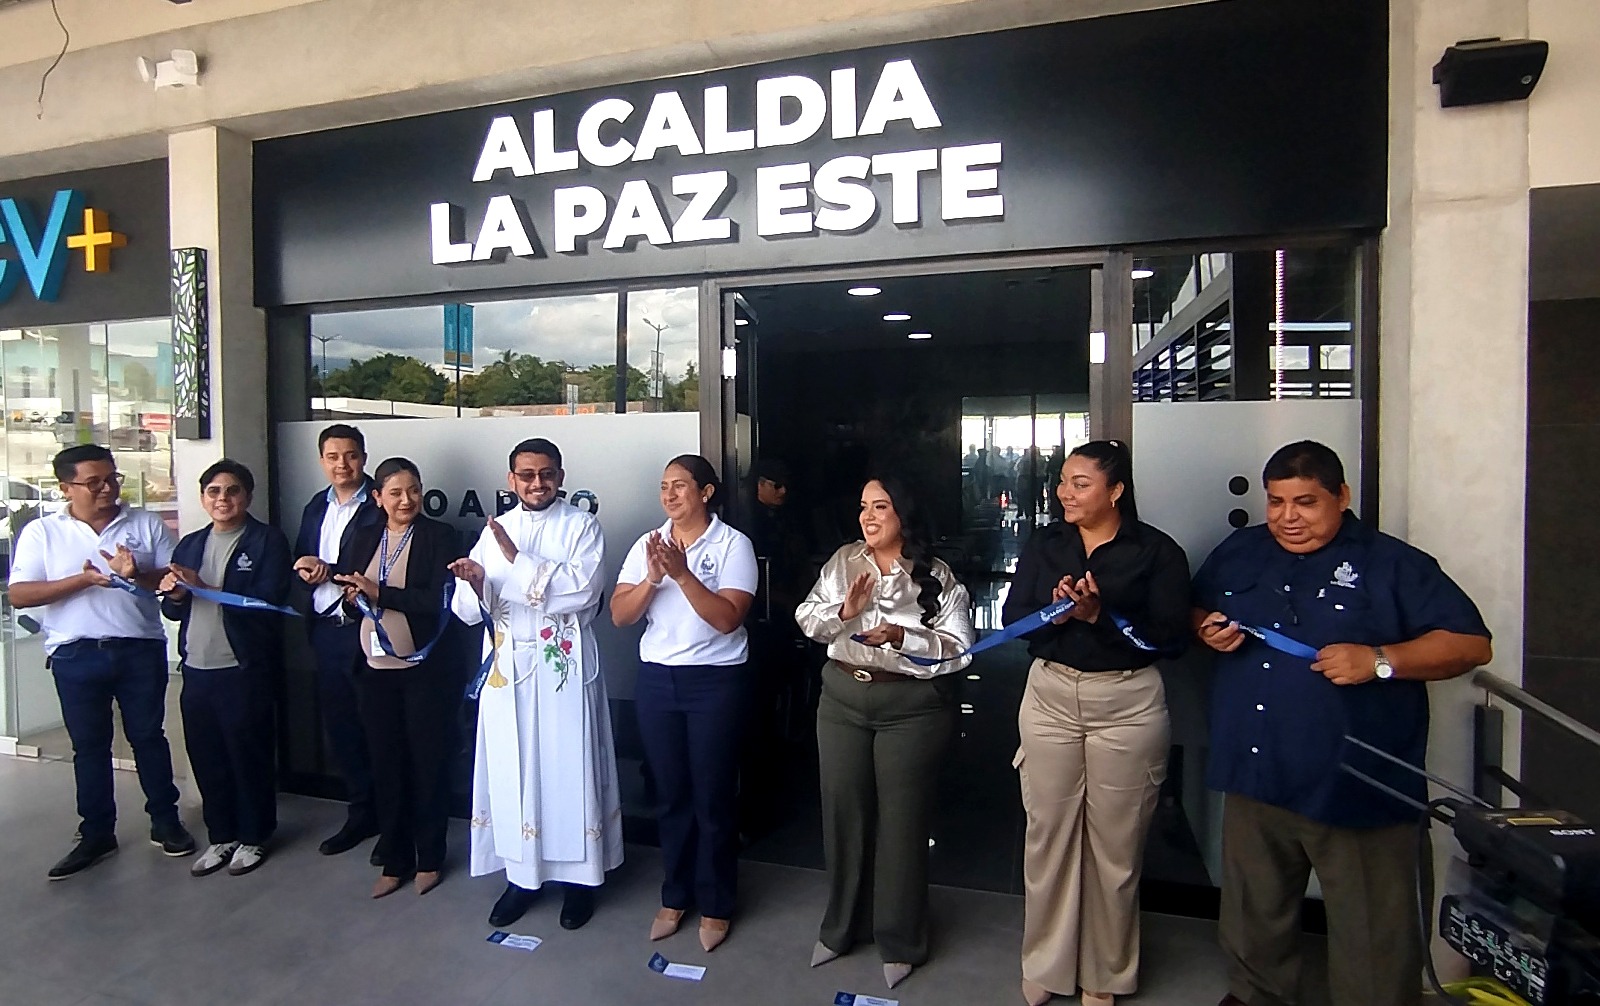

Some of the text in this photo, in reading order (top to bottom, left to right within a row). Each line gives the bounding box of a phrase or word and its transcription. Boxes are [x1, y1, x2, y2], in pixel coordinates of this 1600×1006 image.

[472, 59, 943, 182] ALCALDIA
[430, 142, 1004, 264] LA PAZ ESTE
